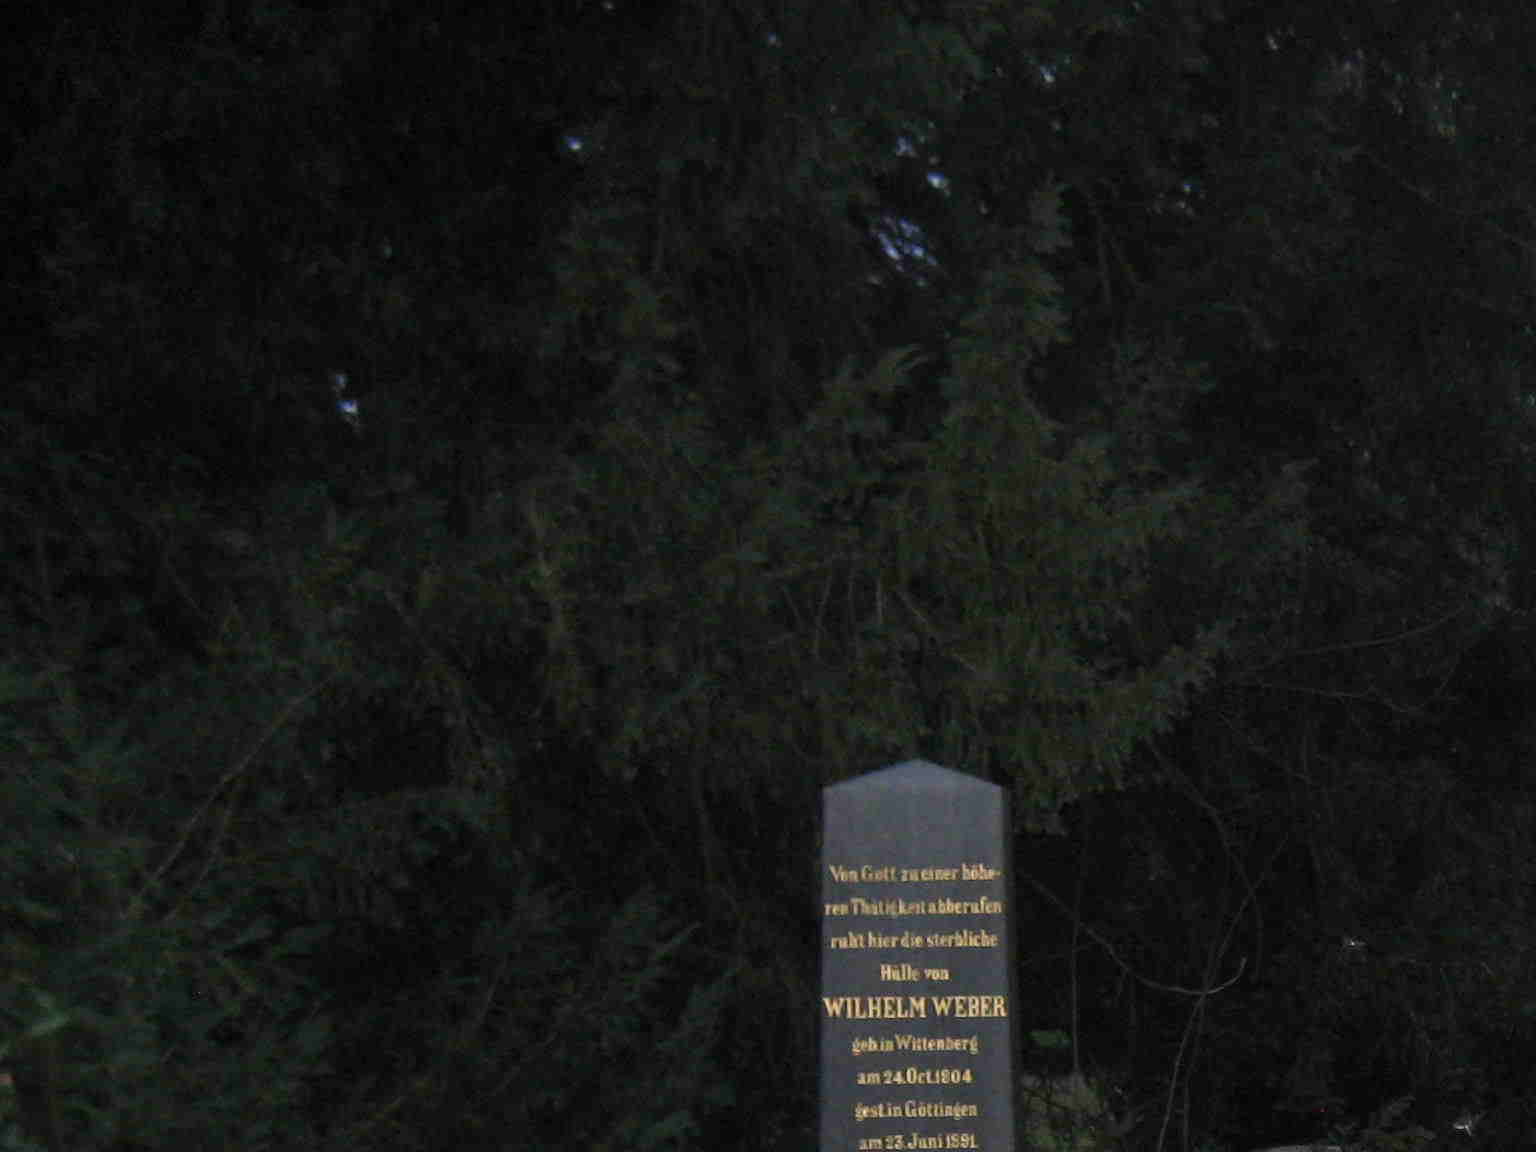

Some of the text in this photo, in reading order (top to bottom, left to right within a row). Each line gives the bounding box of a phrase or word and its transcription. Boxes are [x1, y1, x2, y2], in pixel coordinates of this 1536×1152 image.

[829, 865, 858, 882] Von
[861, 865, 896, 882] Gott
[921, 867, 959, 882] einer
[824, 902, 848, 916] ren
[927, 897, 1002, 916] abberufen
[831, 929, 998, 949] ruht hier die sterbliche
[880, 964, 950, 981] Hülle von
[822, 994, 1008, 1018] WILHELM WEBER
[895, 1034, 979, 1055] Wittenberg
[857, 1072, 881, 1085] am
[904, 1100, 978, 1120] Göttingen
[859, 1137, 882, 1150] am
[907, 1133, 944, 1150] Juni
